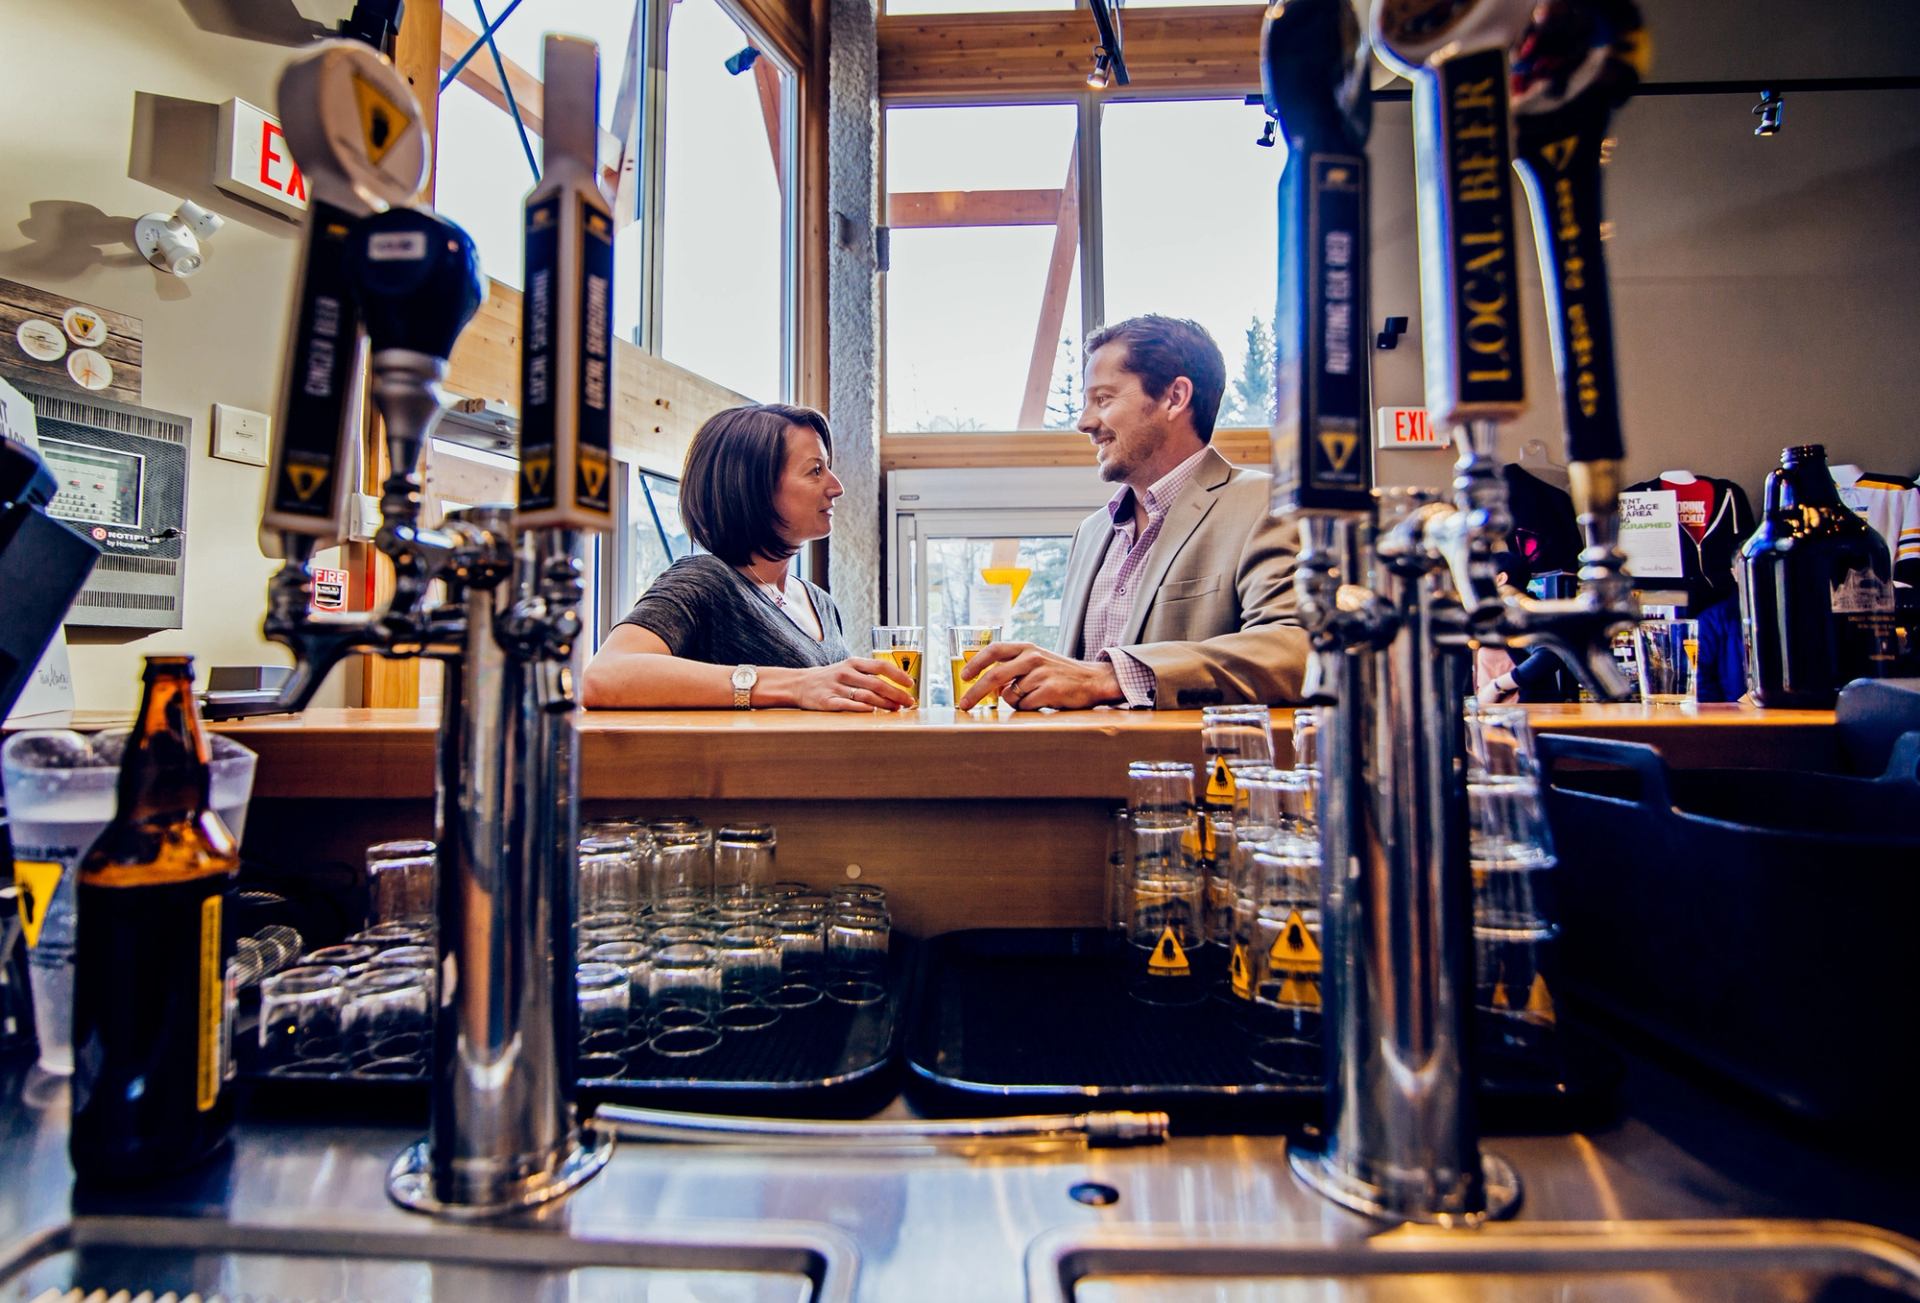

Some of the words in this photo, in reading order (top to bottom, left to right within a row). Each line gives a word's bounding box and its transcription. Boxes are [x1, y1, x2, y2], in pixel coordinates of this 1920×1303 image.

[1454, 76, 1501, 201] BEER
[1461, 213, 1511, 383] LOCAL
[1626, 503, 1660, 511] PLACE
[315, 569, 345, 583] FIRE
